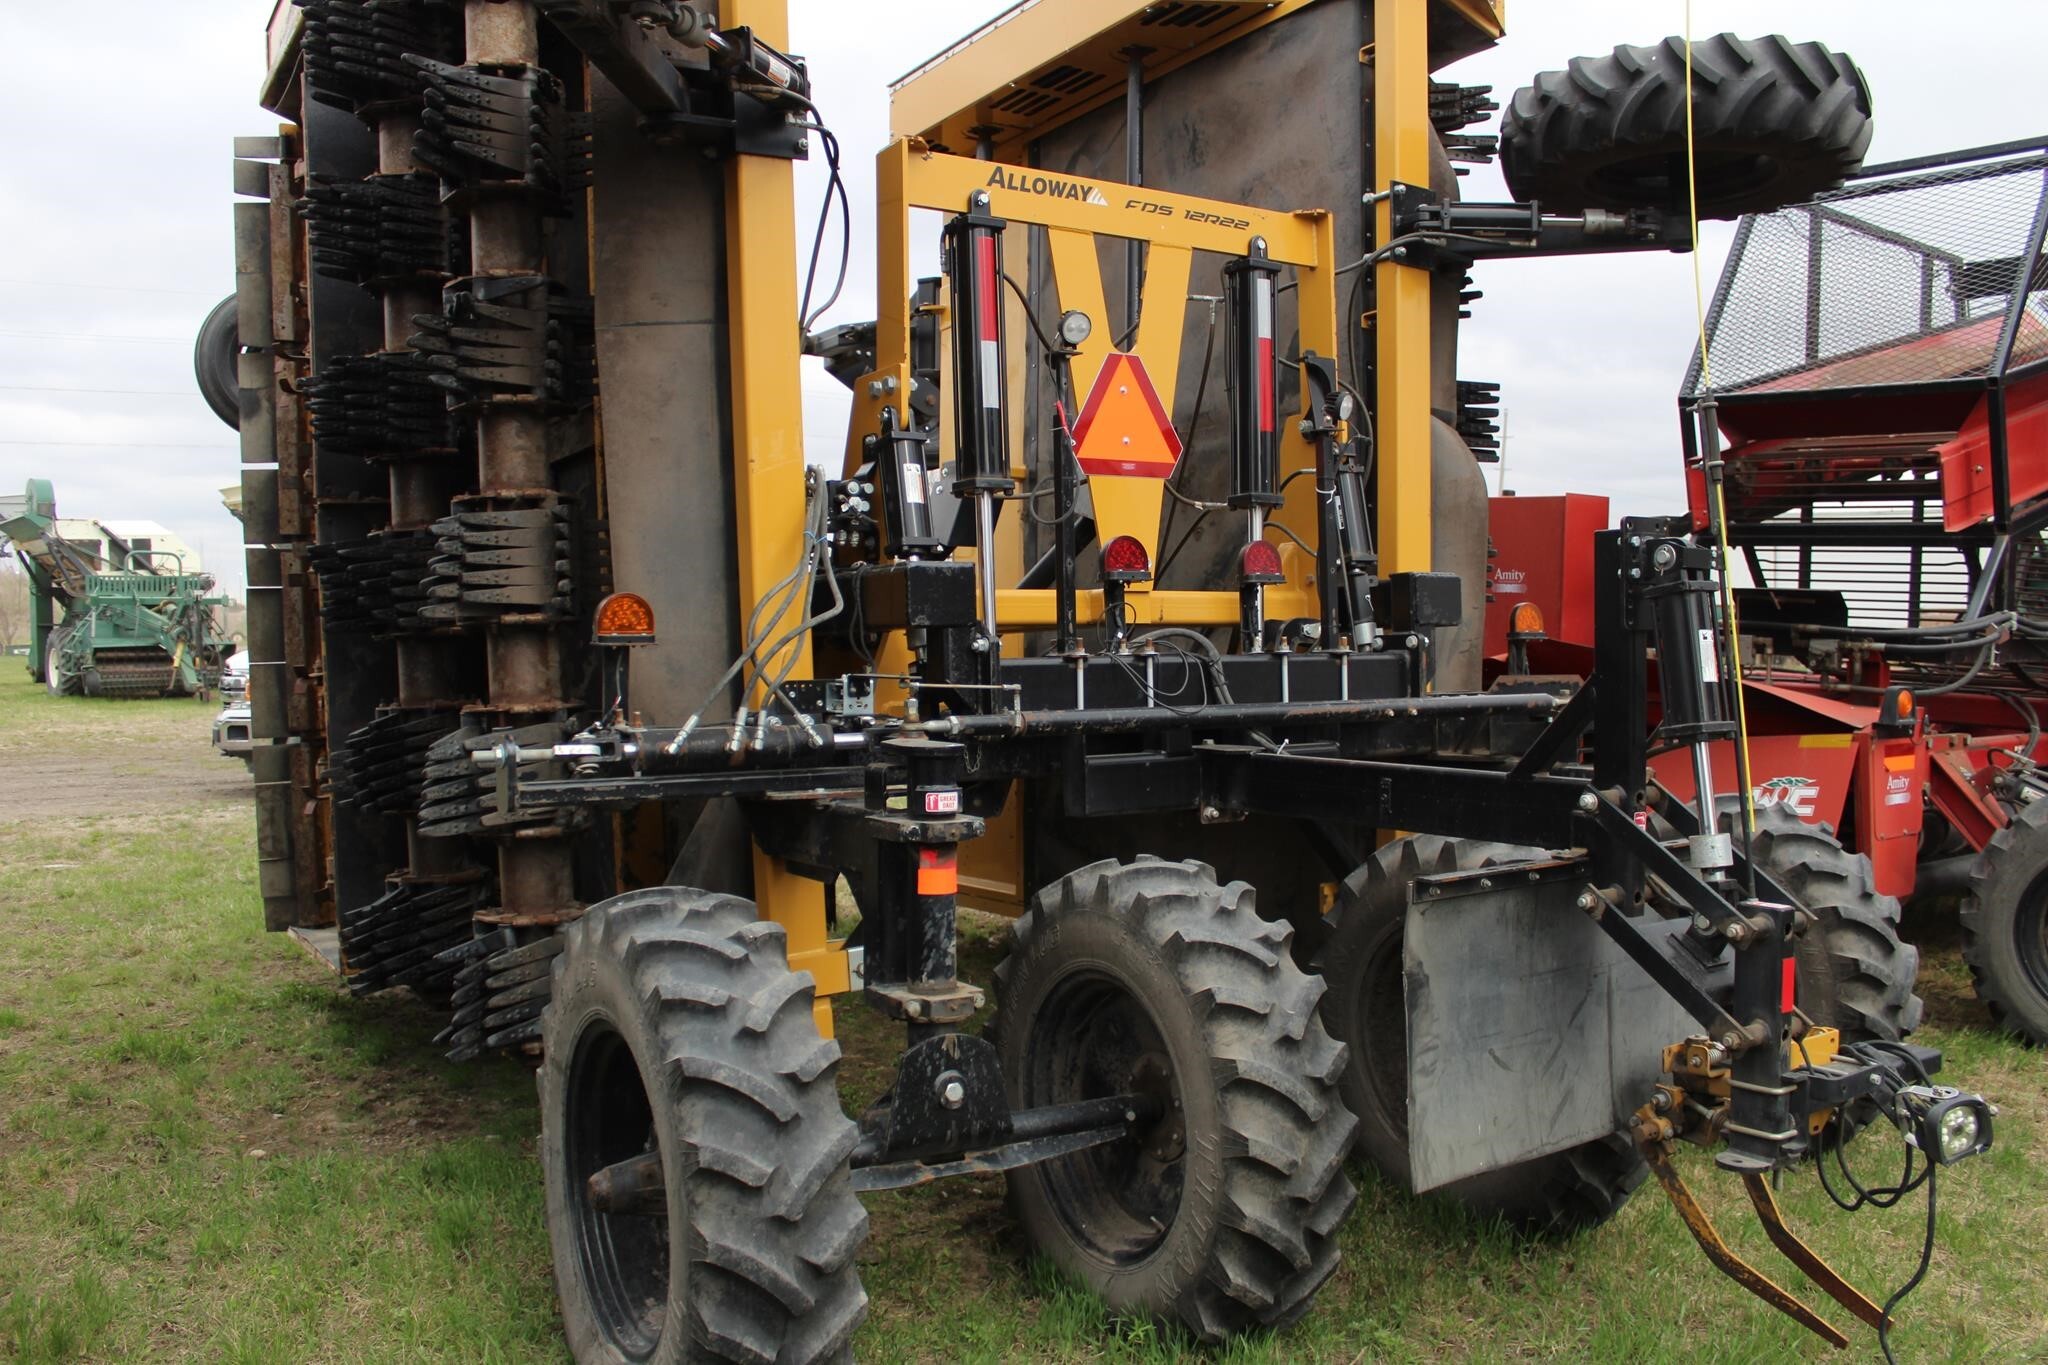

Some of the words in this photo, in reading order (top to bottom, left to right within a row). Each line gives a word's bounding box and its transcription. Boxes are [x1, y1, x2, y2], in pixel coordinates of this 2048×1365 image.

[987, 166, 1093, 201] ALLOWAY
[1125, 199, 1173, 216] FDS
[1184, 209, 1250, 231] 12R22
[1494, 568, 1525, 583] Amity
[1886, 774, 1910, 790] Amity
